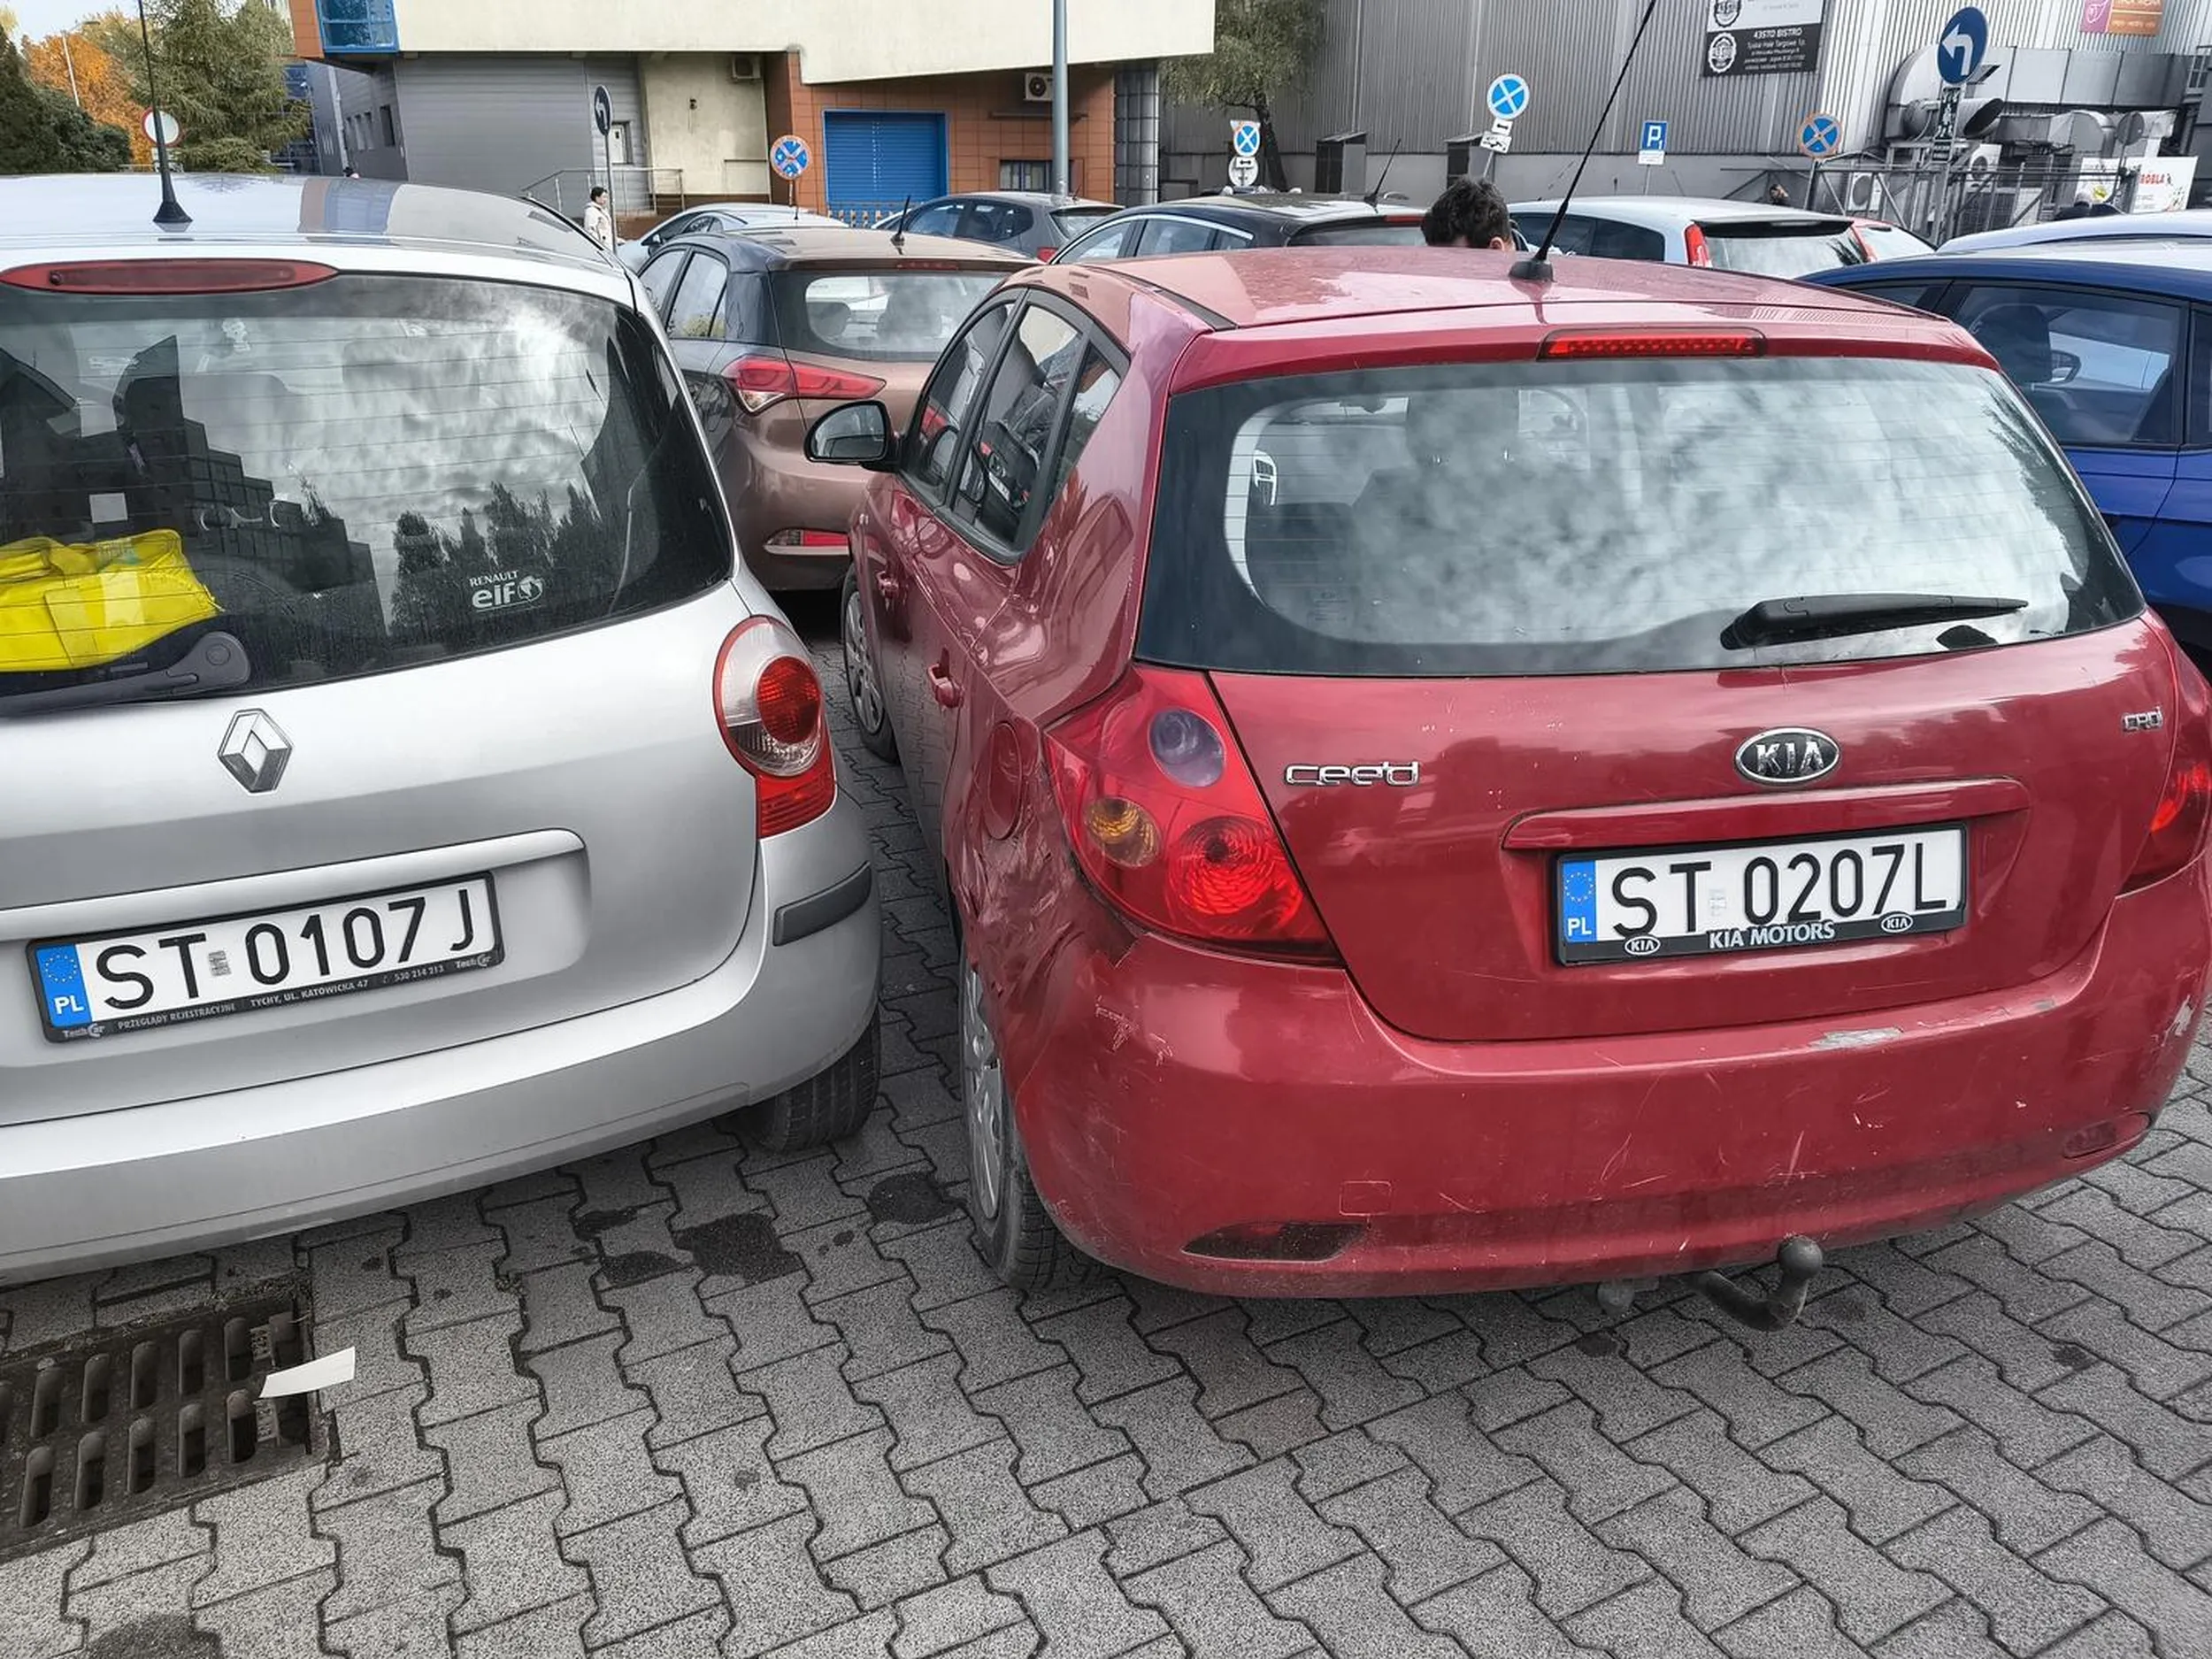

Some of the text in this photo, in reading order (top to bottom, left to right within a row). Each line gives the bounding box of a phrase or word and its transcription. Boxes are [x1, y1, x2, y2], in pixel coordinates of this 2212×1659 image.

[469, 570, 518, 588] RENAULT
[472, 581, 516, 608] elf
[1755, 741, 1824, 774] KIA
[1611, 842, 1947, 938] ST 0207L
[1567, 916, 1592, 938] PL
[1709, 919, 1836, 949] KIA MOTORS
[1886, 916, 1909, 930] KIA
[1629, 939, 1657, 953] KIA
[96, 932, 207, 1010] ST
[284, 990, 299, 1002] UL.
[302, 981, 356, 999] KATOWICKA
[357, 979, 369, 989] 47
[53, 994, 85, 1015] PL
